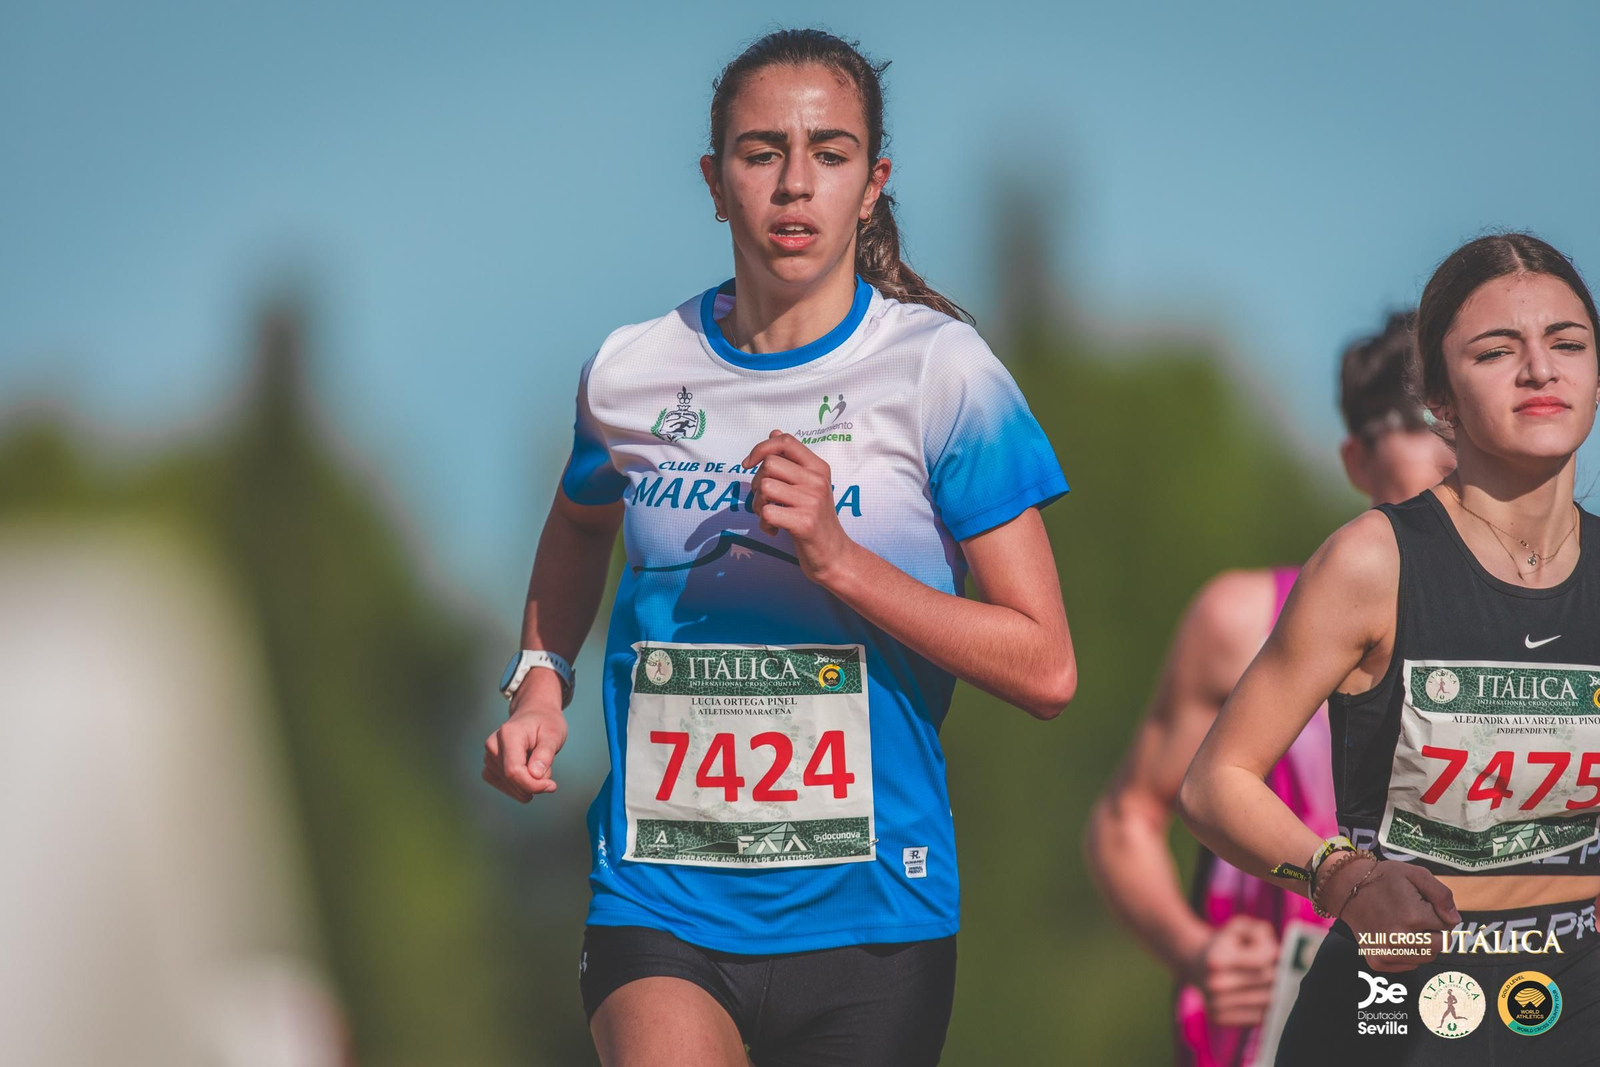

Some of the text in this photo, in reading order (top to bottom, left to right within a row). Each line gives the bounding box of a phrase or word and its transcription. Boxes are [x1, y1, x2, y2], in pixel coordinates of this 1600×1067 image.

[794, 421, 854, 437] Ayuntamiento
[802, 433, 852, 444] Maracena
[659, 461, 700, 472] CLUB
[704, 462, 726, 473] DE
[632, 476, 862, 518] MARAA
[689, 651, 800, 680] ITÁLICA
[689, 680, 742, 688] INTERNATIONAL
[1477, 670, 1579, 700] ITÁLICA
[691, 697, 798, 706] LUCIA ORTEGA PINEL
[1477, 699, 1526, 707] INTERNATIONAL
[1452, 715, 1510, 725] ALEJANDRA
[1512, 716, 1557, 725] ALVAREZ
[1559, 717, 1577, 725] DEL
[1497, 727, 1558, 735] INDEPENDIENTE
[650, 730, 855, 802] 7424
[1420, 745, 1600, 810] 7475
[822, 831, 860, 840] docunova
[674, 853, 718, 862] FEDERACIÓN
[721, 856, 760, 864] ANDALUZA
[774, 853, 815, 862] ATLETISMO
[1429, 850, 1473, 868] FEDERACIÓN
[1474, 856, 1509, 868] ANDALUZA
[1522, 845, 1555, 858] ATLETISMO
